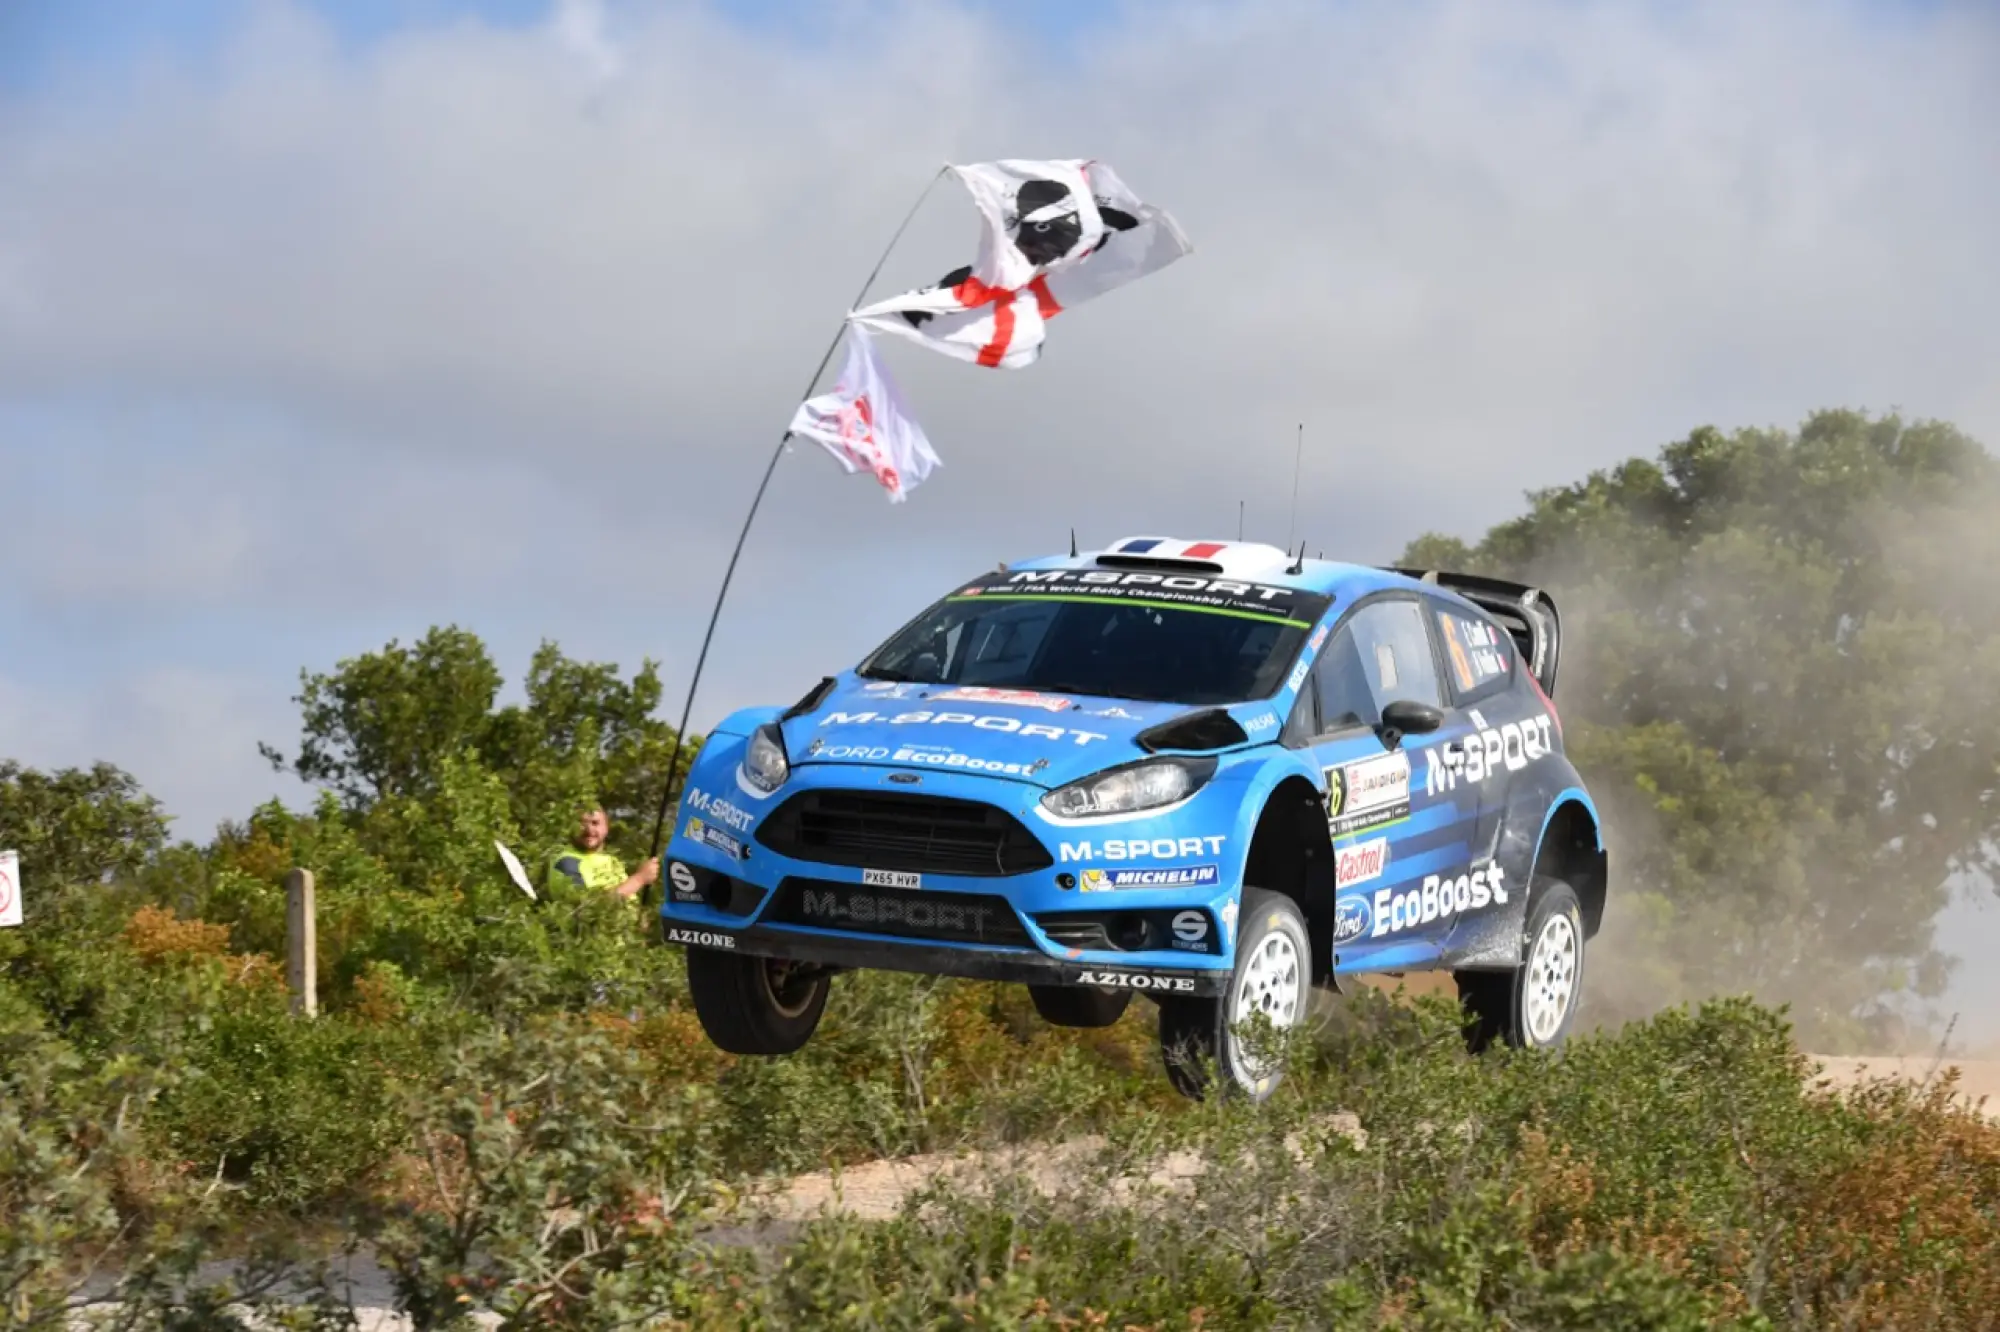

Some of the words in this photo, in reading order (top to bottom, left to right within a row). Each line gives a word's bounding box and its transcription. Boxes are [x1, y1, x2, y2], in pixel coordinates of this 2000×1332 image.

[1009, 571, 1292, 600] M-SPORT
[1050, 585, 1089, 594] World
[1090, 586, 1125, 596] Rally
[1128, 588, 1223, 605] Championship
[819, 711, 1108, 746] M-SPORT
[813, 747, 890, 760] FORD
[892, 748, 1034, 777] EcoBoost
[1425, 714, 1552, 797] M-SPORT
[1331, 770, 1341, 816] 6
[687, 787, 754, 832] M-SPORT
[1059, 836, 1226, 862] M-SPORT
[1338, 844, 1381, 884] Castrol
[865, 872, 893, 885] PX65
[897, 874, 918, 886] HVR
[1115, 867, 1215, 885] MICHELIN
[803, 889, 993, 931] M-SPORT
[1371, 859, 1508, 938] EcoBoost
[668, 928, 735, 949] AZIONE
[1076, 970, 1195, 991] AZIONE
